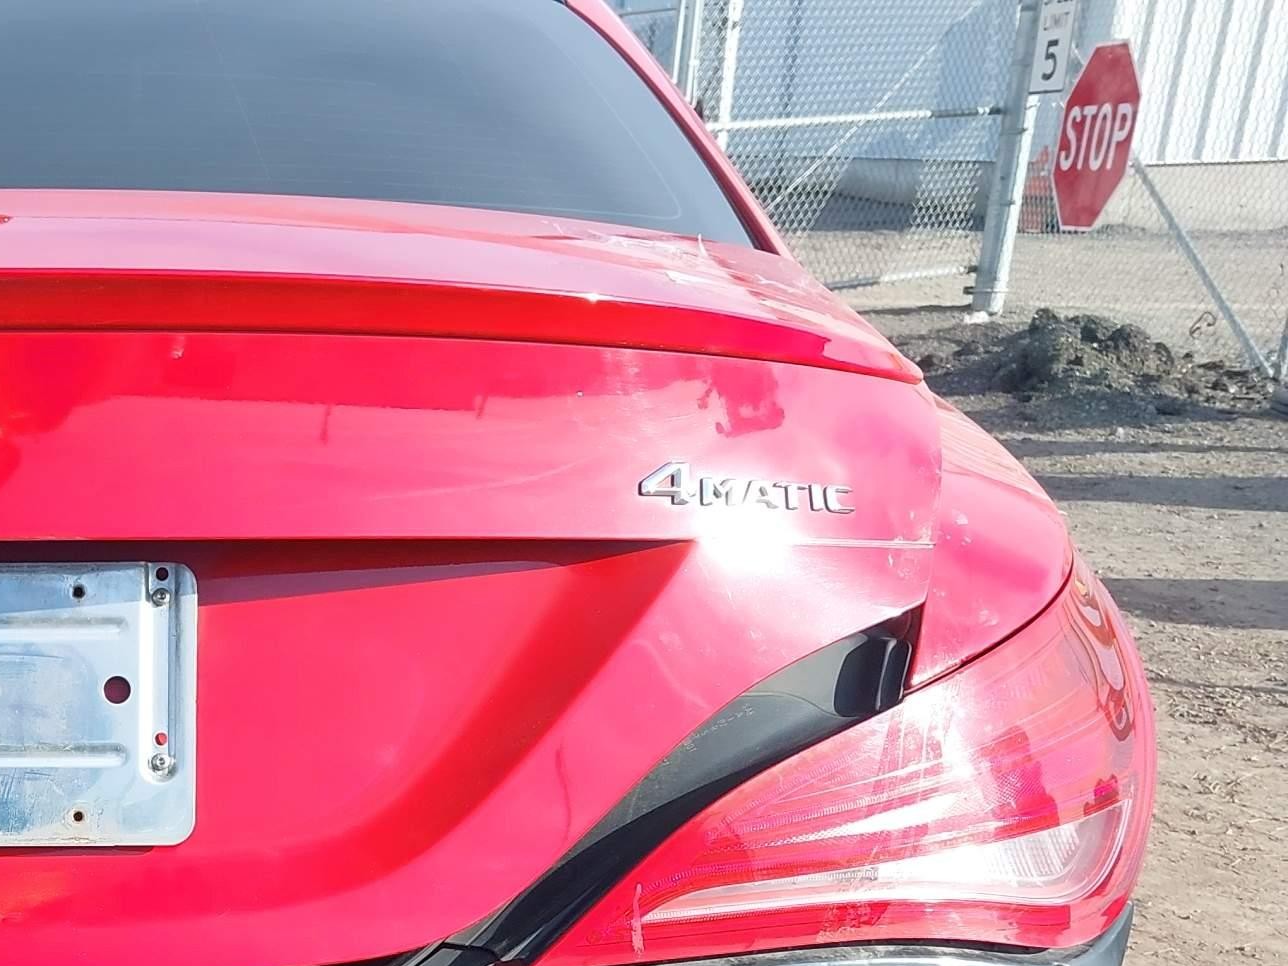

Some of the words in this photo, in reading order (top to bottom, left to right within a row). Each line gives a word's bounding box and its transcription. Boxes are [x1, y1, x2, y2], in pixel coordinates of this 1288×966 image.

[1041, 39, 1060, 81] 5
[1059, 102, 1133, 171] STOP
[637, 460, 856, 515] 4MATIC
